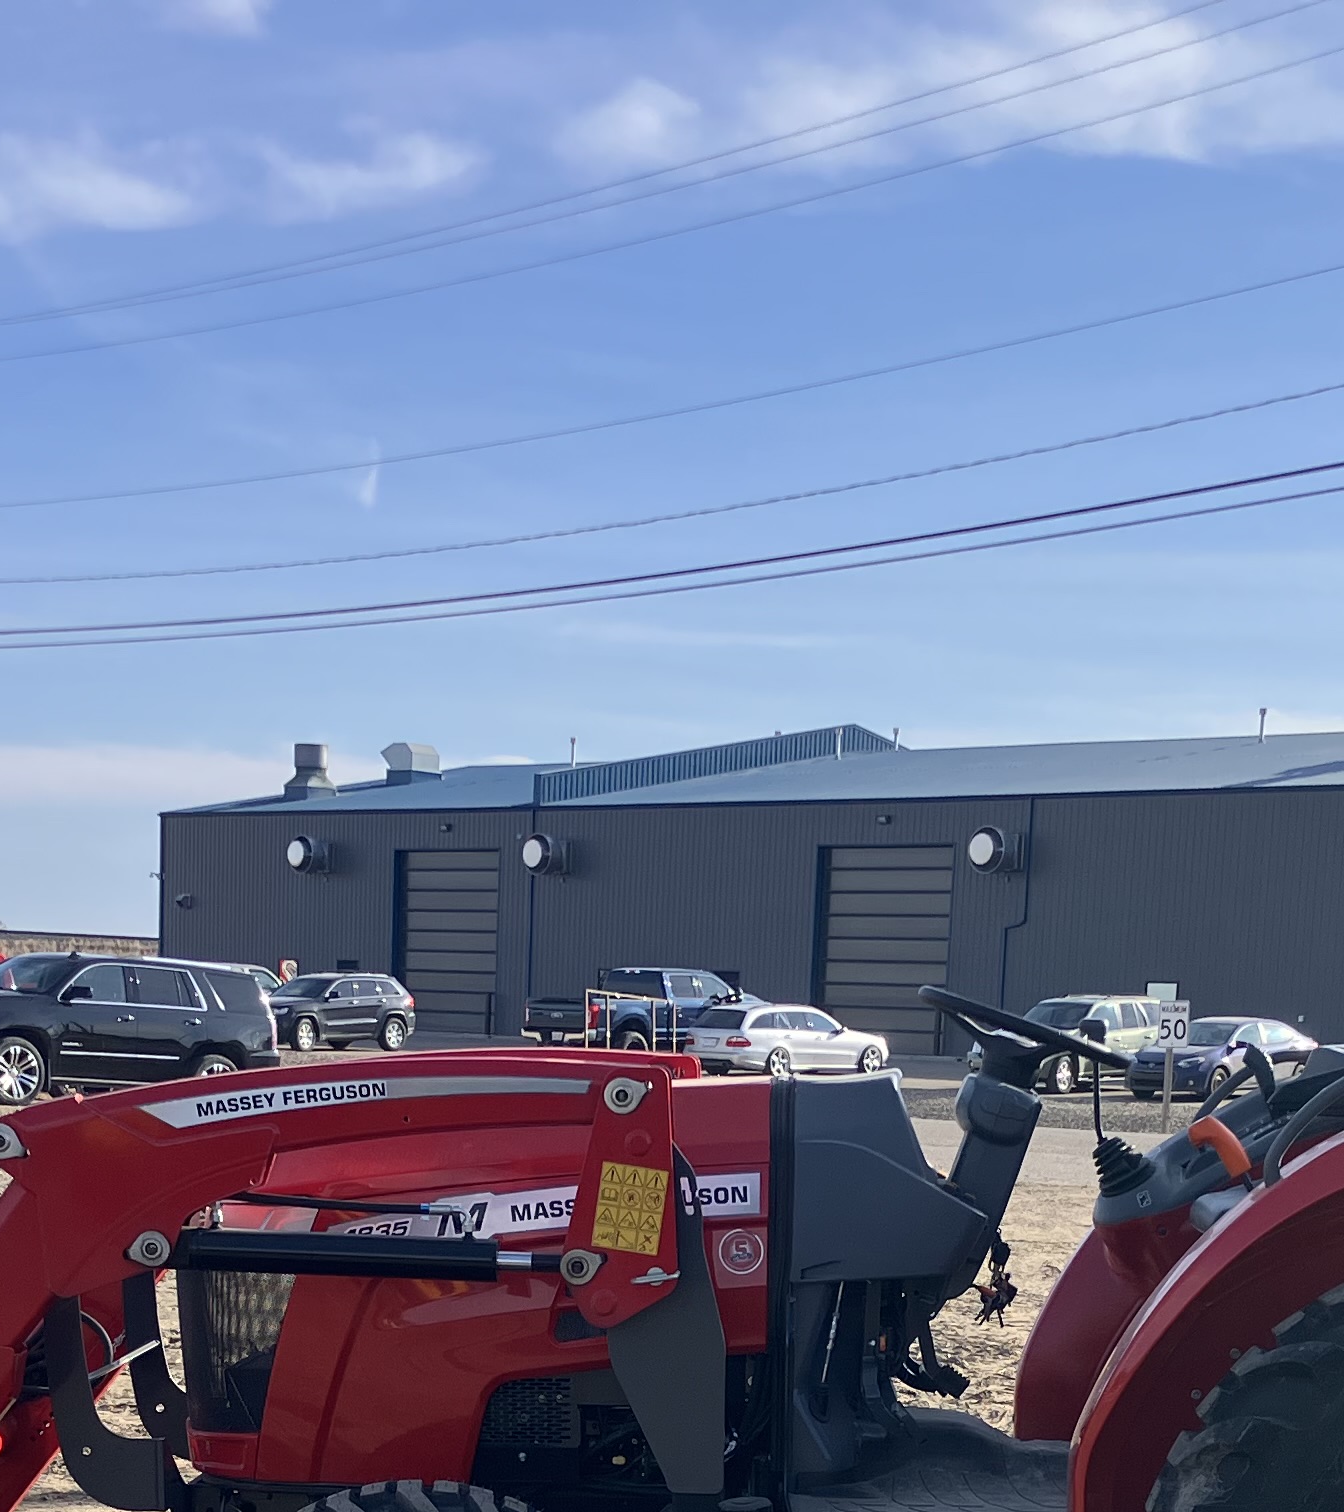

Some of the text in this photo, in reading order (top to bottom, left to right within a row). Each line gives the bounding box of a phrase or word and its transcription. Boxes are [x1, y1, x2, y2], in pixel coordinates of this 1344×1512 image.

[1160, 1018, 1186, 1039] 50
[196, 1082, 386, 1117] MASSEY FERGUSON
[510, 1185, 748, 1223] MASS USON
